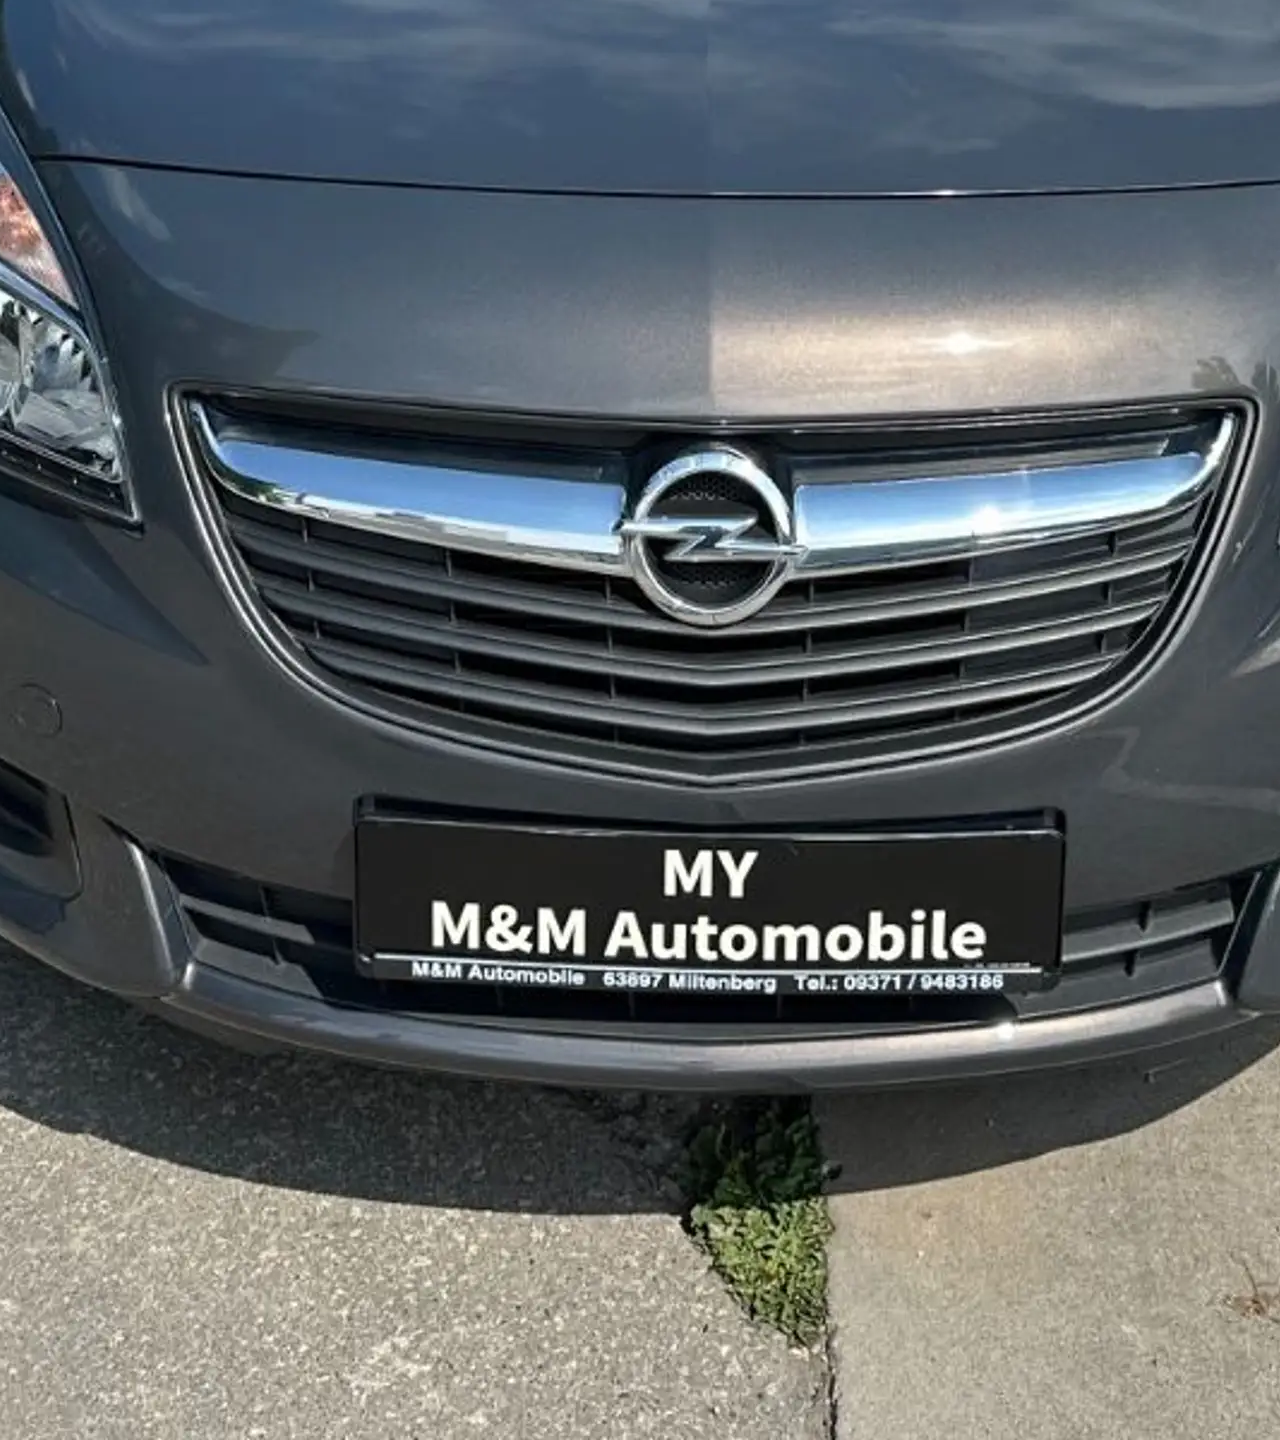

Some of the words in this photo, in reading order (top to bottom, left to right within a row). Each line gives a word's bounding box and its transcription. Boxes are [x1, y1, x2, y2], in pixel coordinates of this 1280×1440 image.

[663, 849, 759, 898] MY
[431, 901, 587, 956] M&M
[604, 910, 987, 962] Automobile
[411, 962, 462, 979] M&M
[468, 964, 586, 986] Automobile
[602, 971, 662, 988] 63897
[669, 972, 777, 994] Miltenberg
[794, 973, 838, 991] Tel.:
[844, 973, 901, 991] 09371
[907, 973, 917, 991] /
